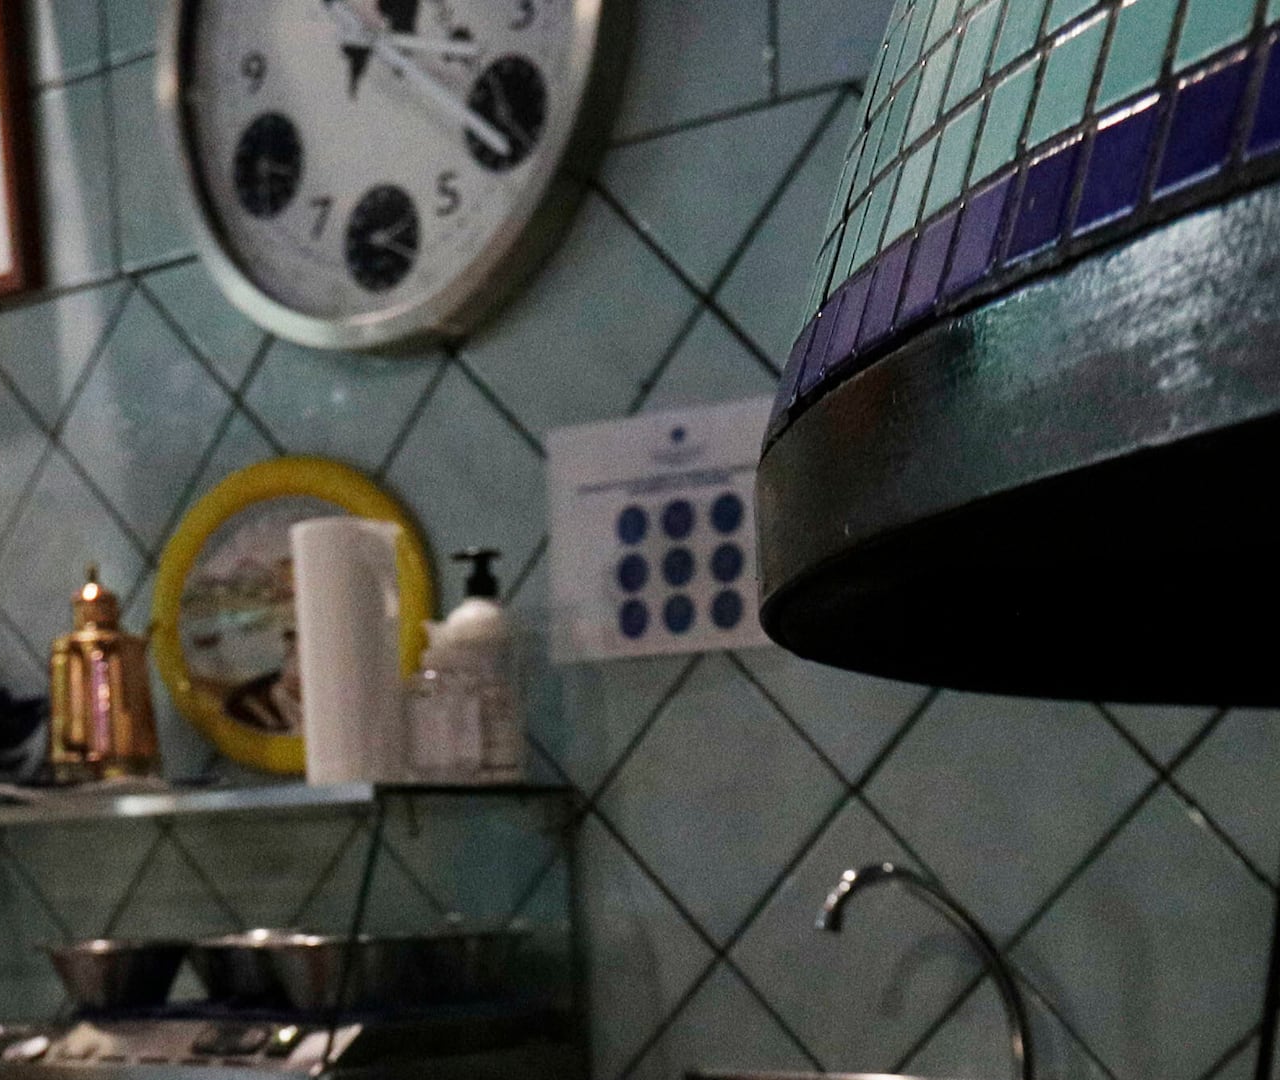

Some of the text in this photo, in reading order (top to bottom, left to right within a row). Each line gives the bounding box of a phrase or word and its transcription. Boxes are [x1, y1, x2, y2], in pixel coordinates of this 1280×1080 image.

[241, 52, 267, 95] 9
[435, 170, 461, 218] 5
[310, 197, 333, 239] 7
